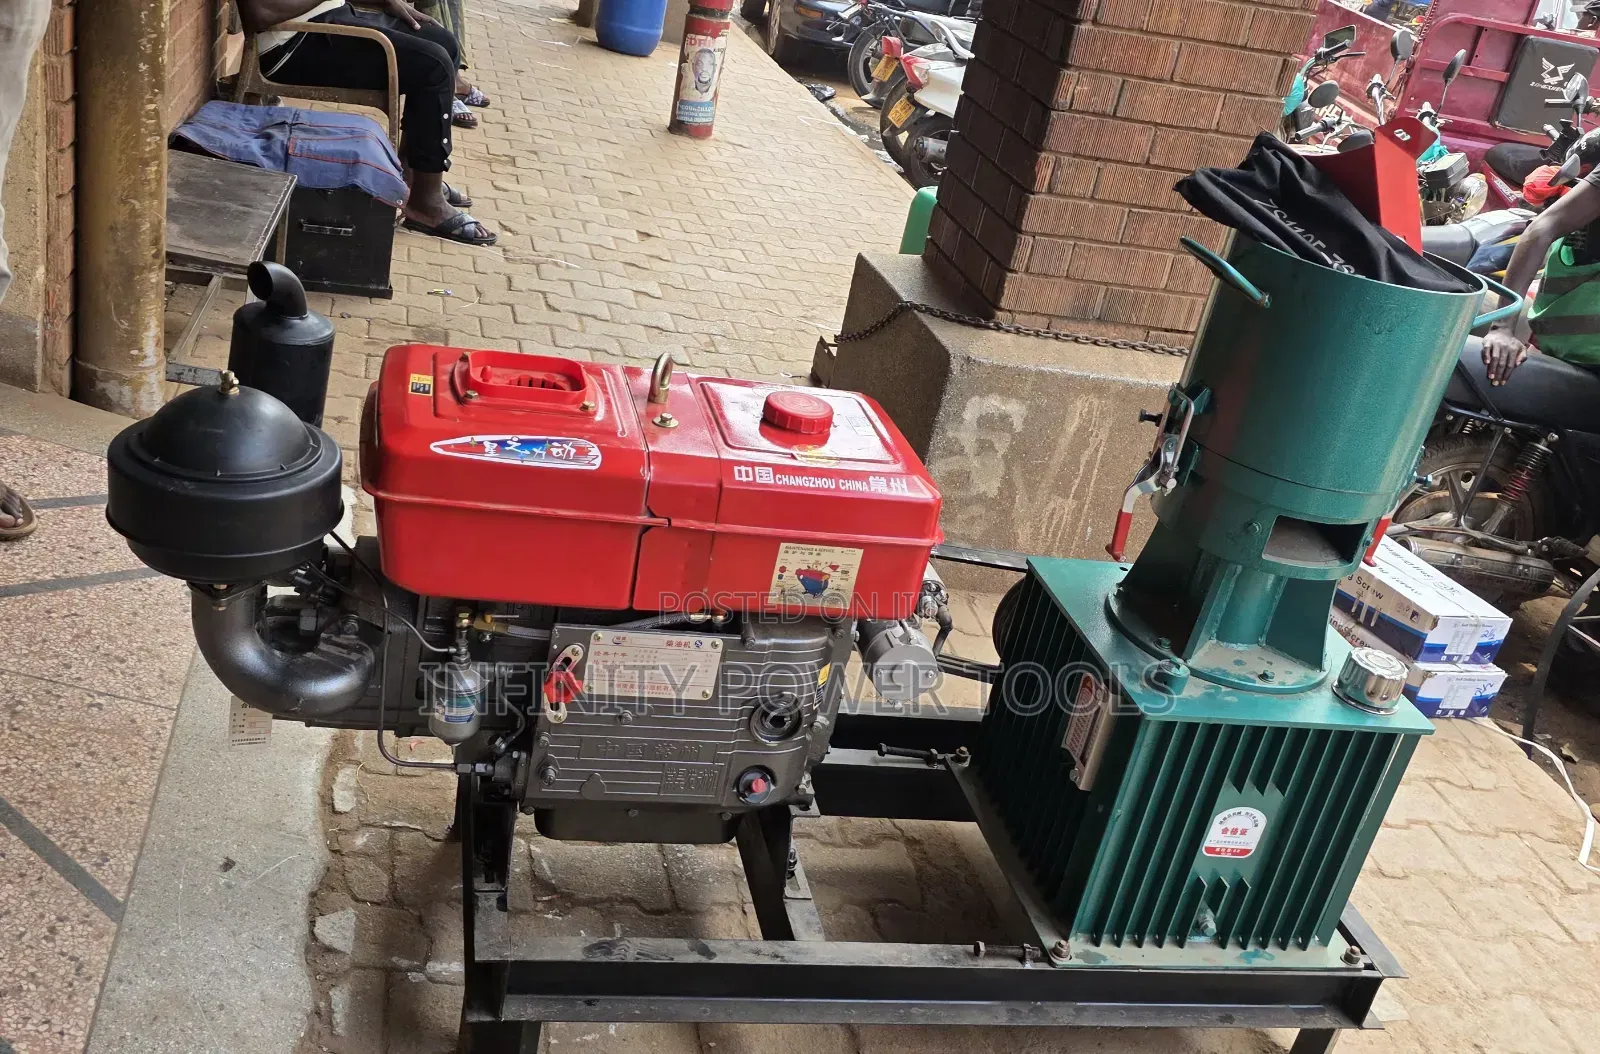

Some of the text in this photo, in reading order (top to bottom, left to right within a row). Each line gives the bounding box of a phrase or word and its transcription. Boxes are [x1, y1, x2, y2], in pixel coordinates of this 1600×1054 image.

[733, 465, 775, 484] 中国
[775, 475, 836, 489] CHANGZHOU
[839, 479, 869, 492] CHINA
[1355, 575, 1383, 600] Screw
[1221, 827, 1248, 835] 合格证
